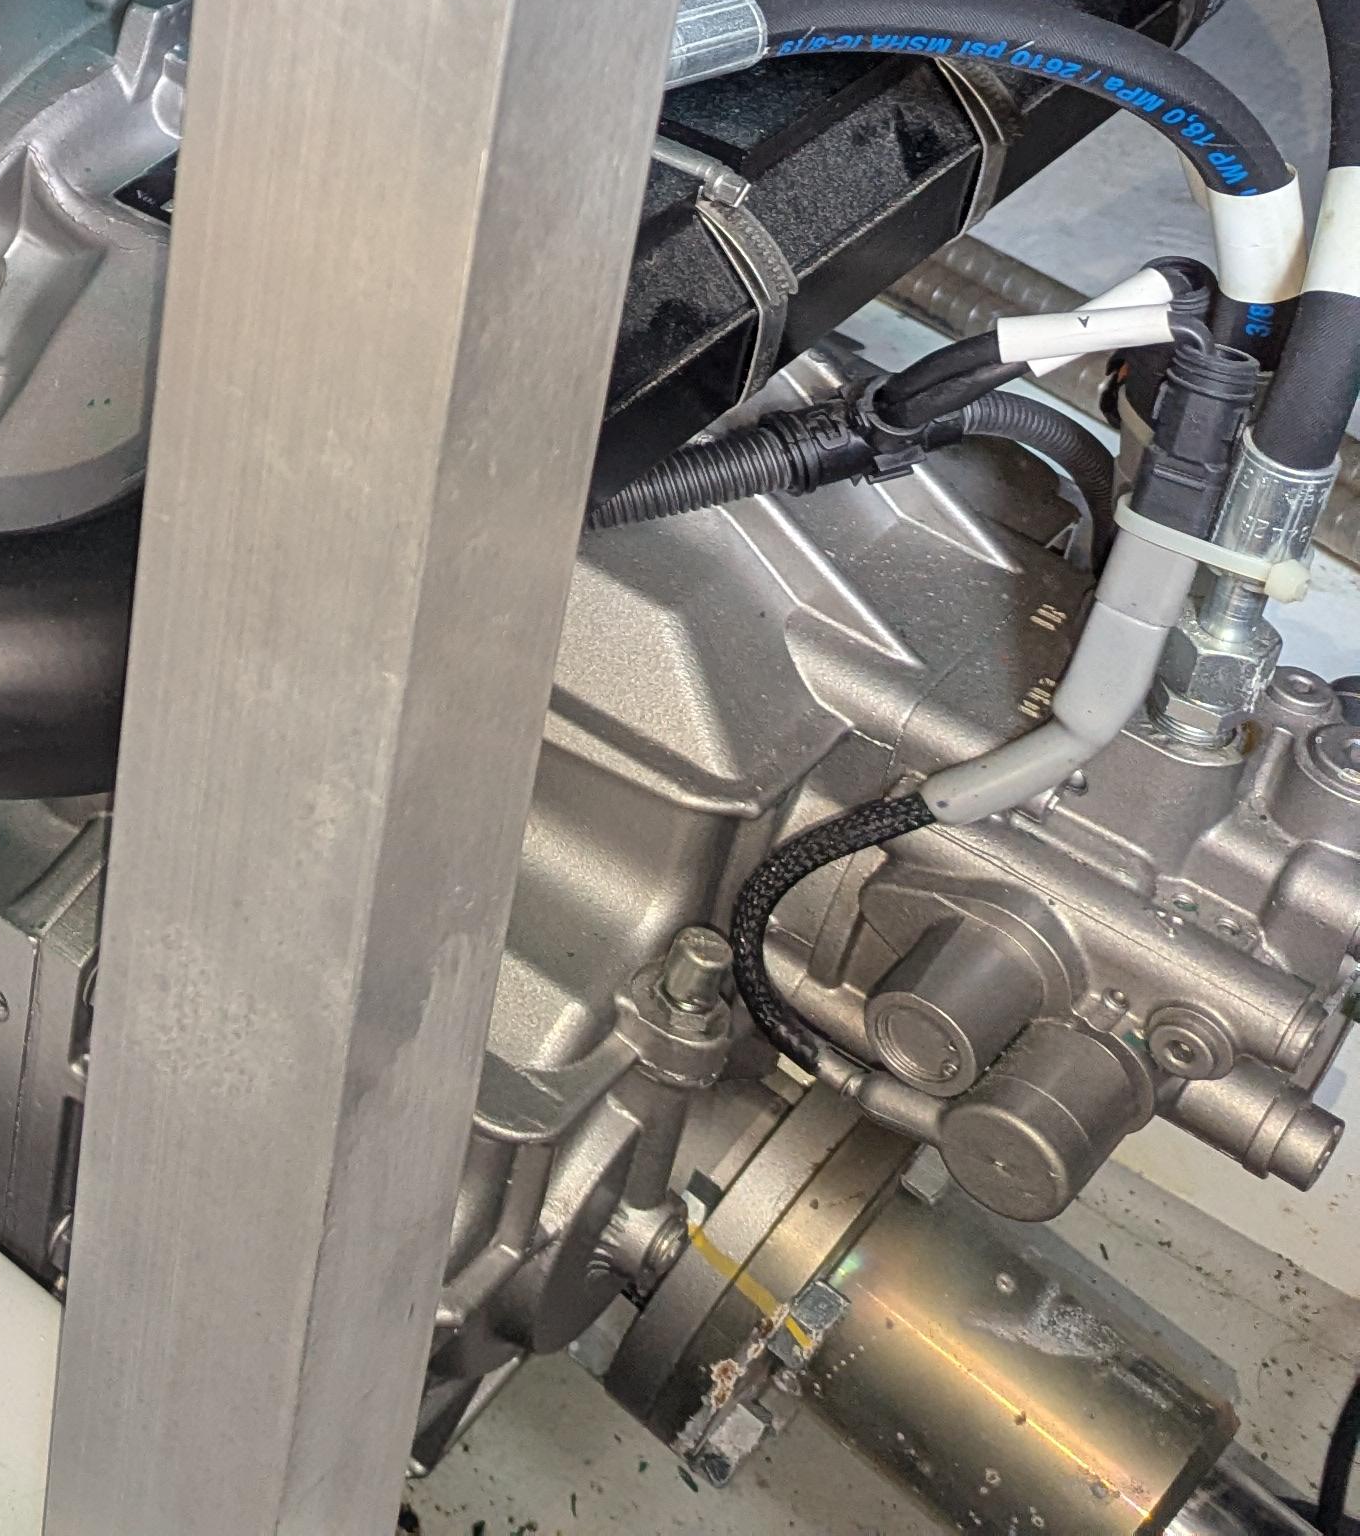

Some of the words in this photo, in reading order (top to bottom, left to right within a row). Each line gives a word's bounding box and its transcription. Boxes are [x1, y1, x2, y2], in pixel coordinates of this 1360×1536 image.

[872, 33, 953, 55] MSHA
[957, 40, 1008, 60] psi
[1009, 48, 1084, 81] 2610
[1102, 74, 1166, 113] MPa
[1207, 151, 1250, 185] WP
